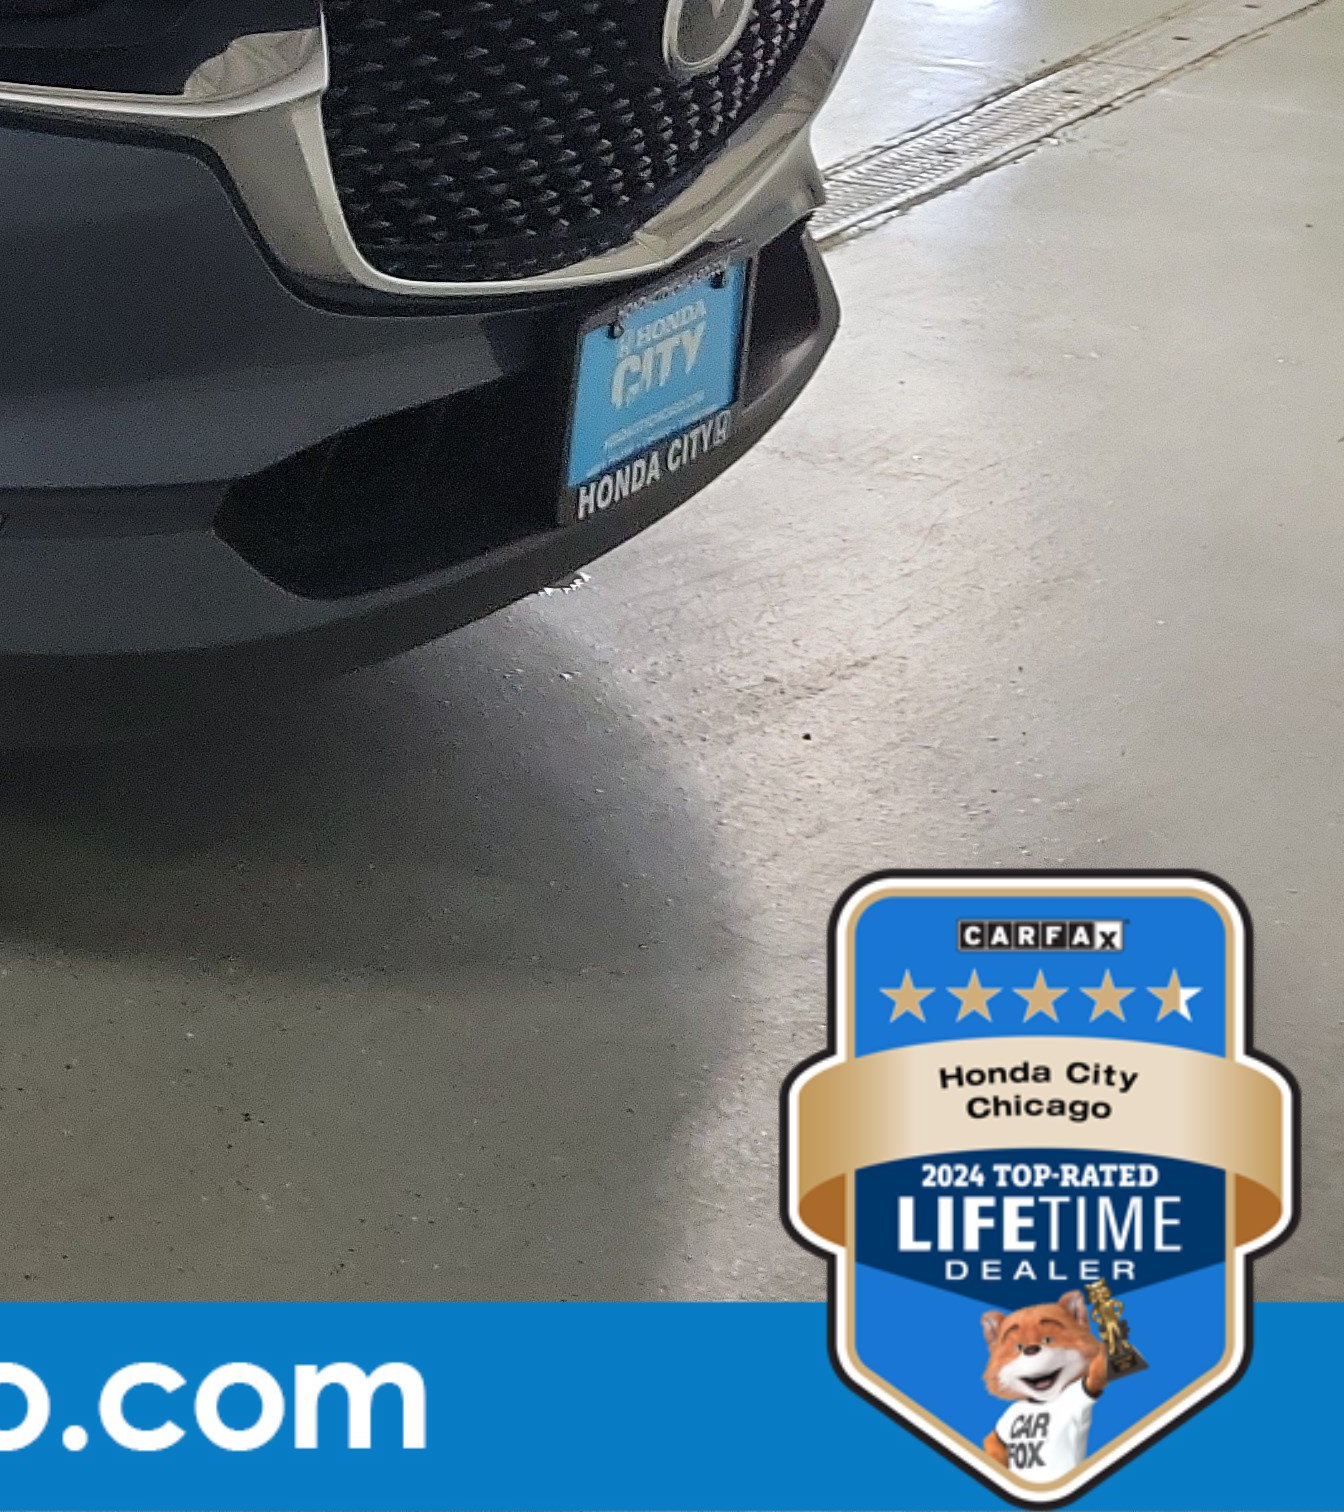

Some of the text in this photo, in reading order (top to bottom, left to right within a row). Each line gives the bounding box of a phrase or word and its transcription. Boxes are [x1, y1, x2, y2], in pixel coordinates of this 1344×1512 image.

[611, 321, 706, 409] CITY
[577, 450, 662, 521] HONDA
[666, 419, 714, 463] CITY
